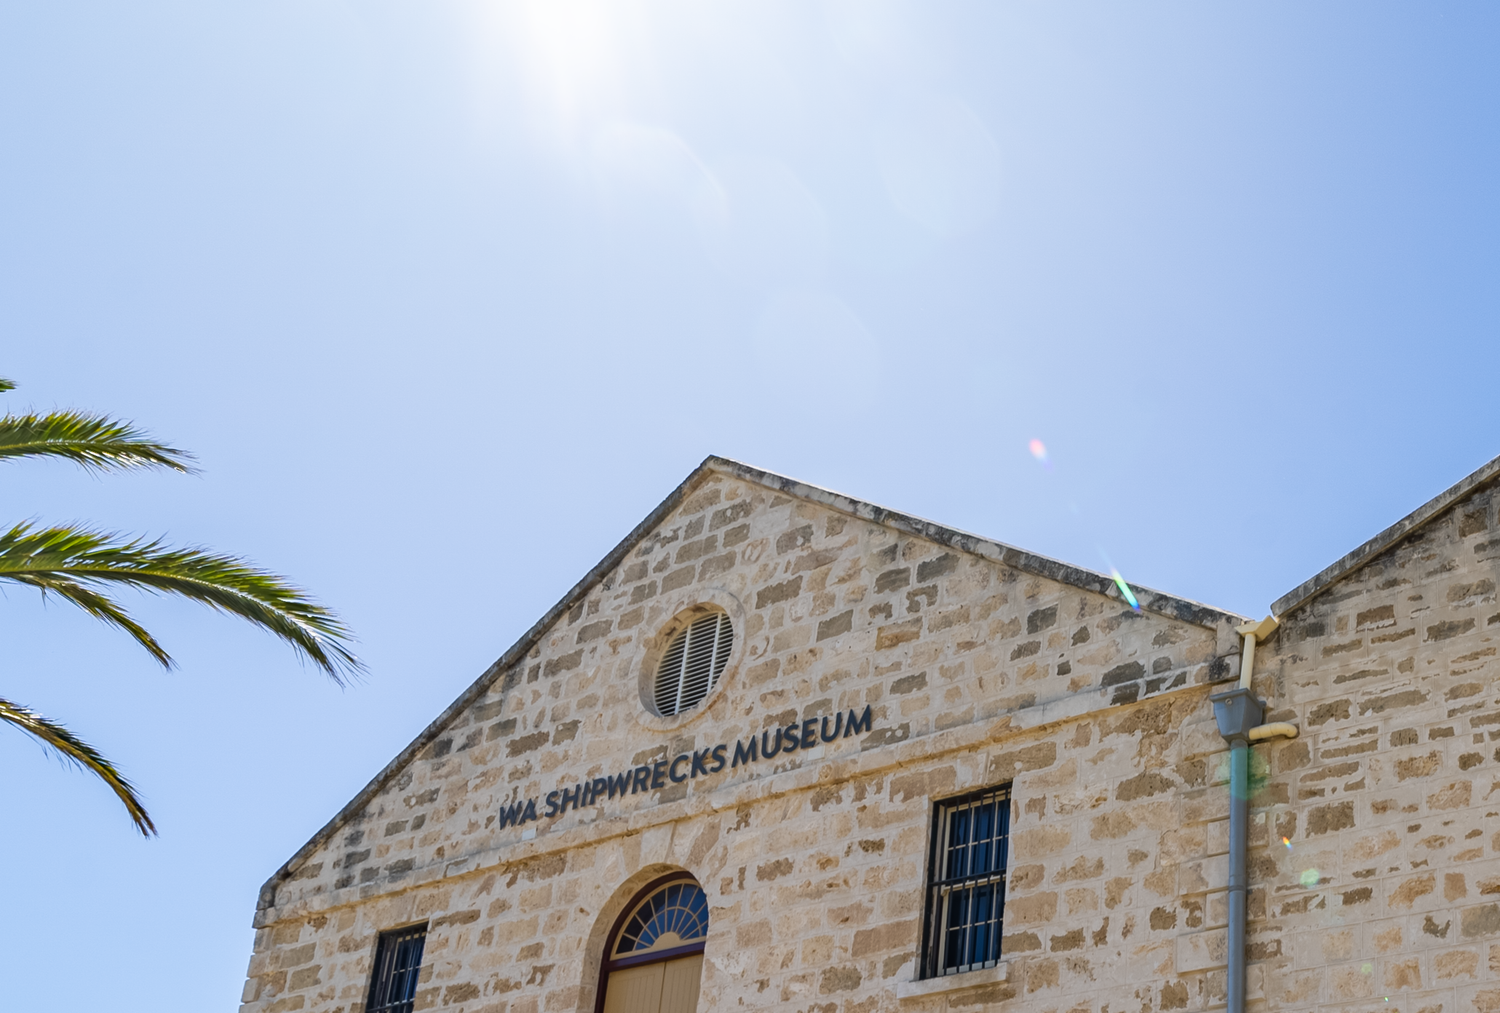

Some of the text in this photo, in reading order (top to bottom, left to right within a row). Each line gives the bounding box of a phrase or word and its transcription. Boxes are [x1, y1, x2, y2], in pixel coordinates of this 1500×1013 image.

[500, 704, 872, 830] WA SHIPWRECKS MUSEUM
